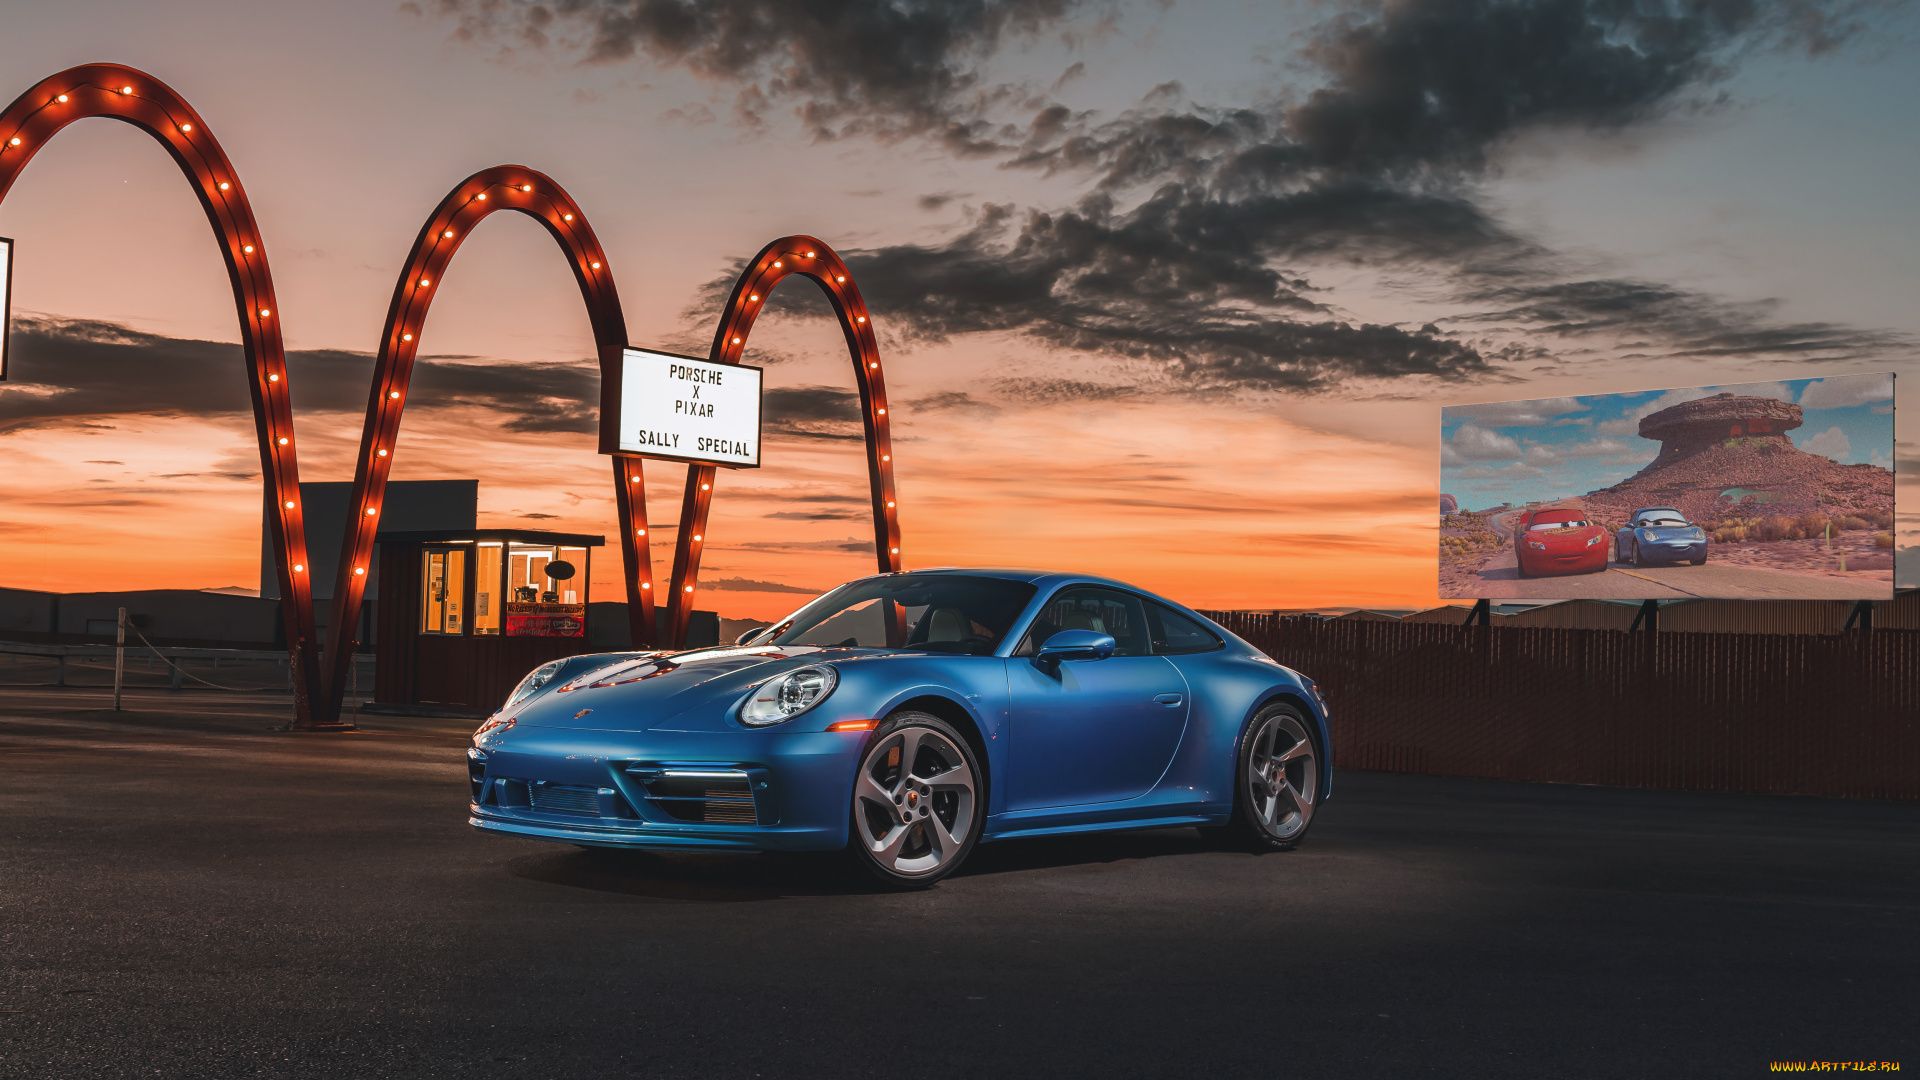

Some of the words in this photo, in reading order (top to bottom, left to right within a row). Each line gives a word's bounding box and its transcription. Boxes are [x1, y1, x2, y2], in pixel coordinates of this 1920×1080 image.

[670, 364, 723, 386] PORSCHE
[692, 385, 700, 399] X
[675, 400, 714, 418] PIXAR
[639, 429, 680, 448] SALLY
[697, 437, 750, 456] SPECIAL
